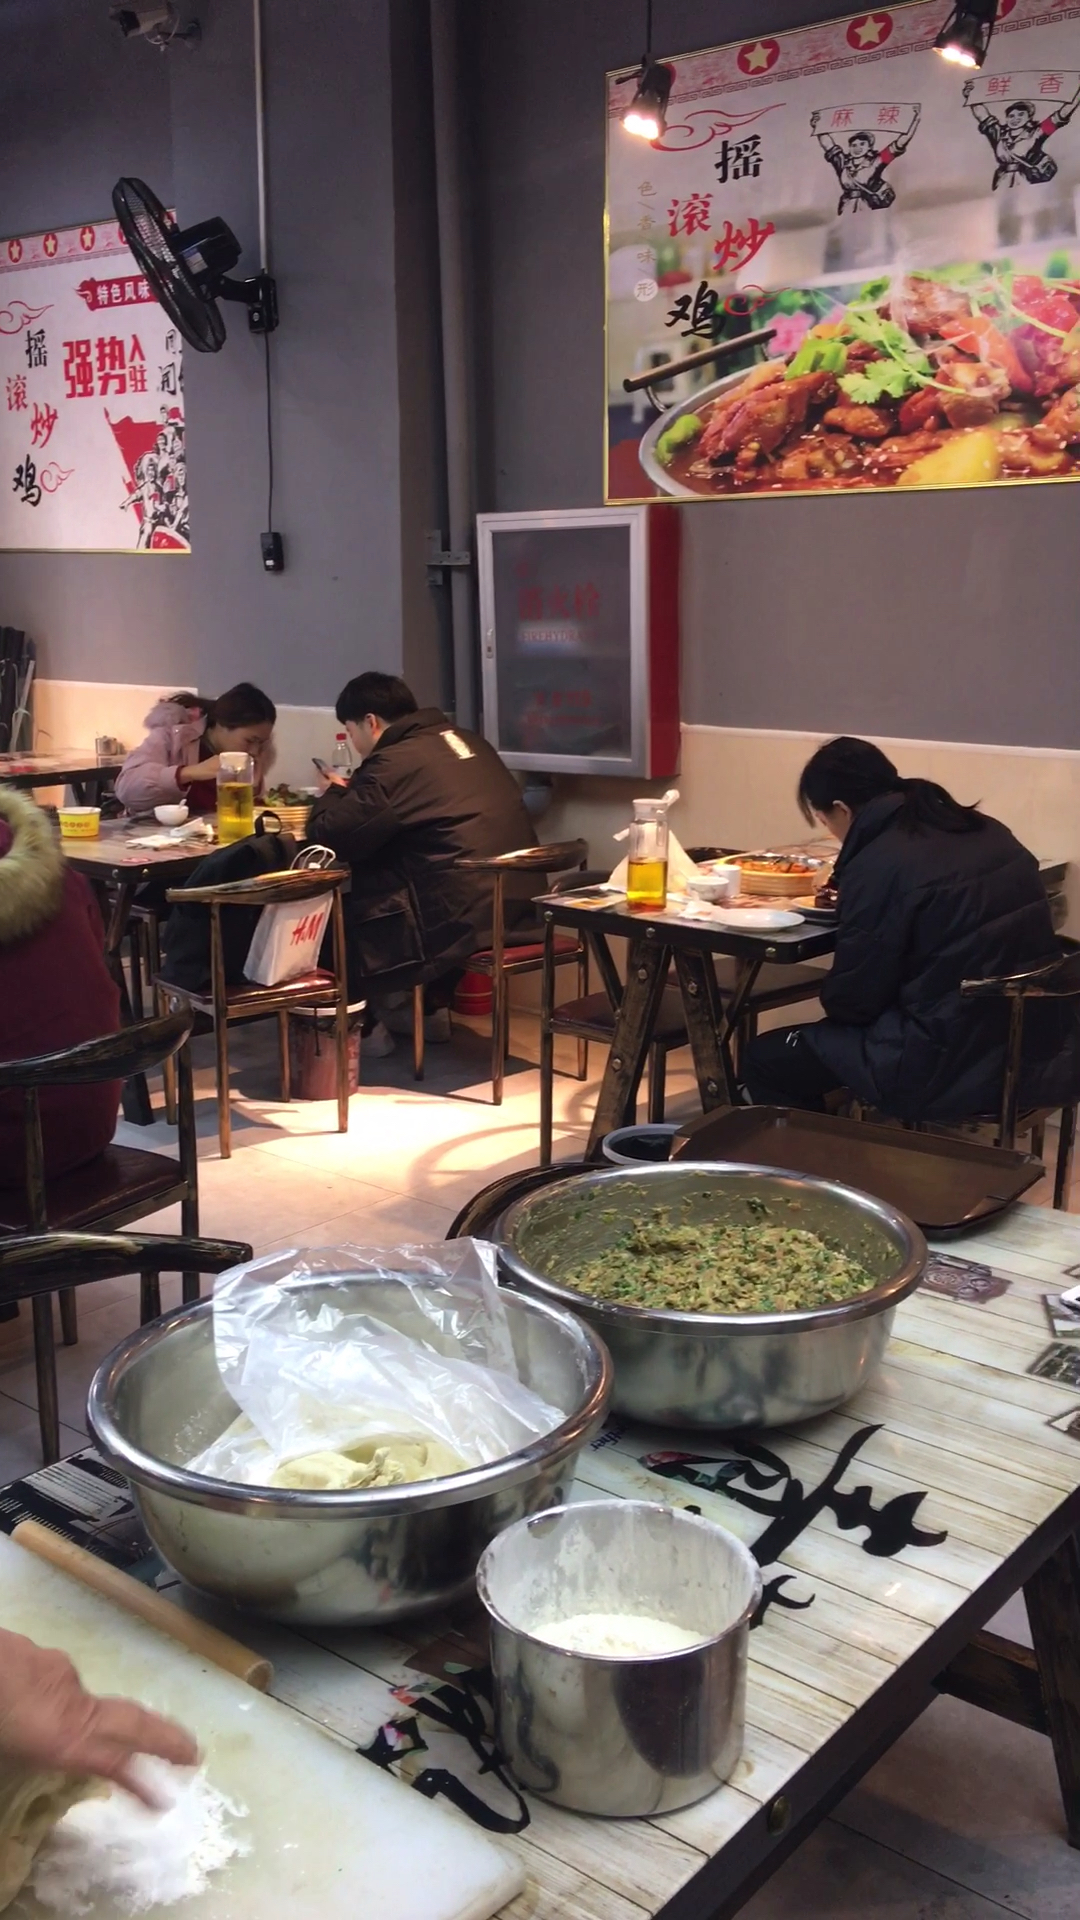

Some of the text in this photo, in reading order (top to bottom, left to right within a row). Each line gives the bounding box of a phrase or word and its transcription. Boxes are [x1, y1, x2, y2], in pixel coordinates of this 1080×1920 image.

[985, 72, 1064, 97] 鲜香
[830, 105, 901, 128] 麻辣
[97, 279, 151, 306] 特色风味
